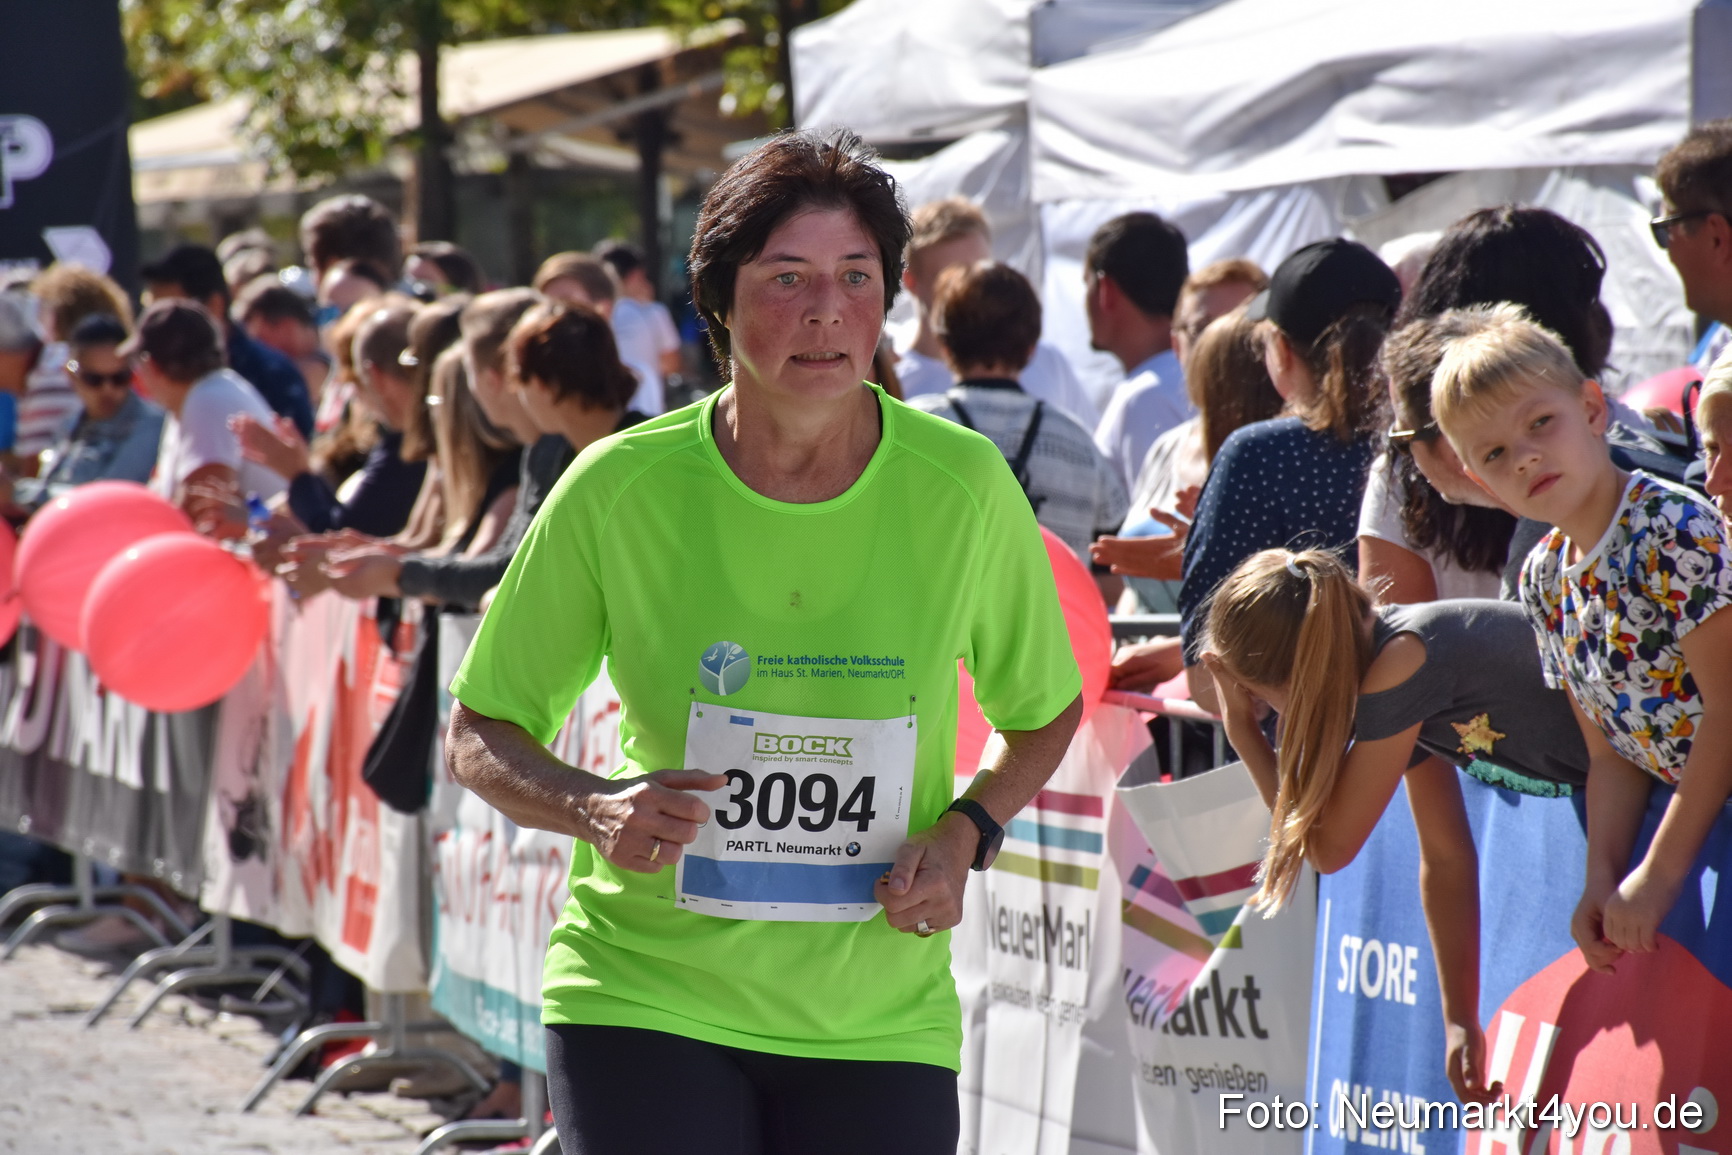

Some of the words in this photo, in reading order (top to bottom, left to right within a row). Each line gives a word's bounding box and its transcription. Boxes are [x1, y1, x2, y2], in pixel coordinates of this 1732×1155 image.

[757, 655, 784, 665] Freie
[787, 655, 848, 666] katholische
[850, 655, 905, 667] Volksschule
[756, 668, 768, 678] im
[771, 668, 794, 678] Haus
[796, 668, 808, 678] St.
[811, 668, 845, 679] Marien,
[753, 732, 854, 758] BOCK
[752, 754, 783, 763] inspired
[784, 755, 793, 763] by
[819, 757, 854, 766] concepts
[715, 768, 876, 833] 3094
[726, 840, 773, 853] PARTL
[776, 842, 842, 856] Neumarkt
[1337, 934, 1419, 1006] STORE
[1185, 1063, 1268, 1095] genießen
